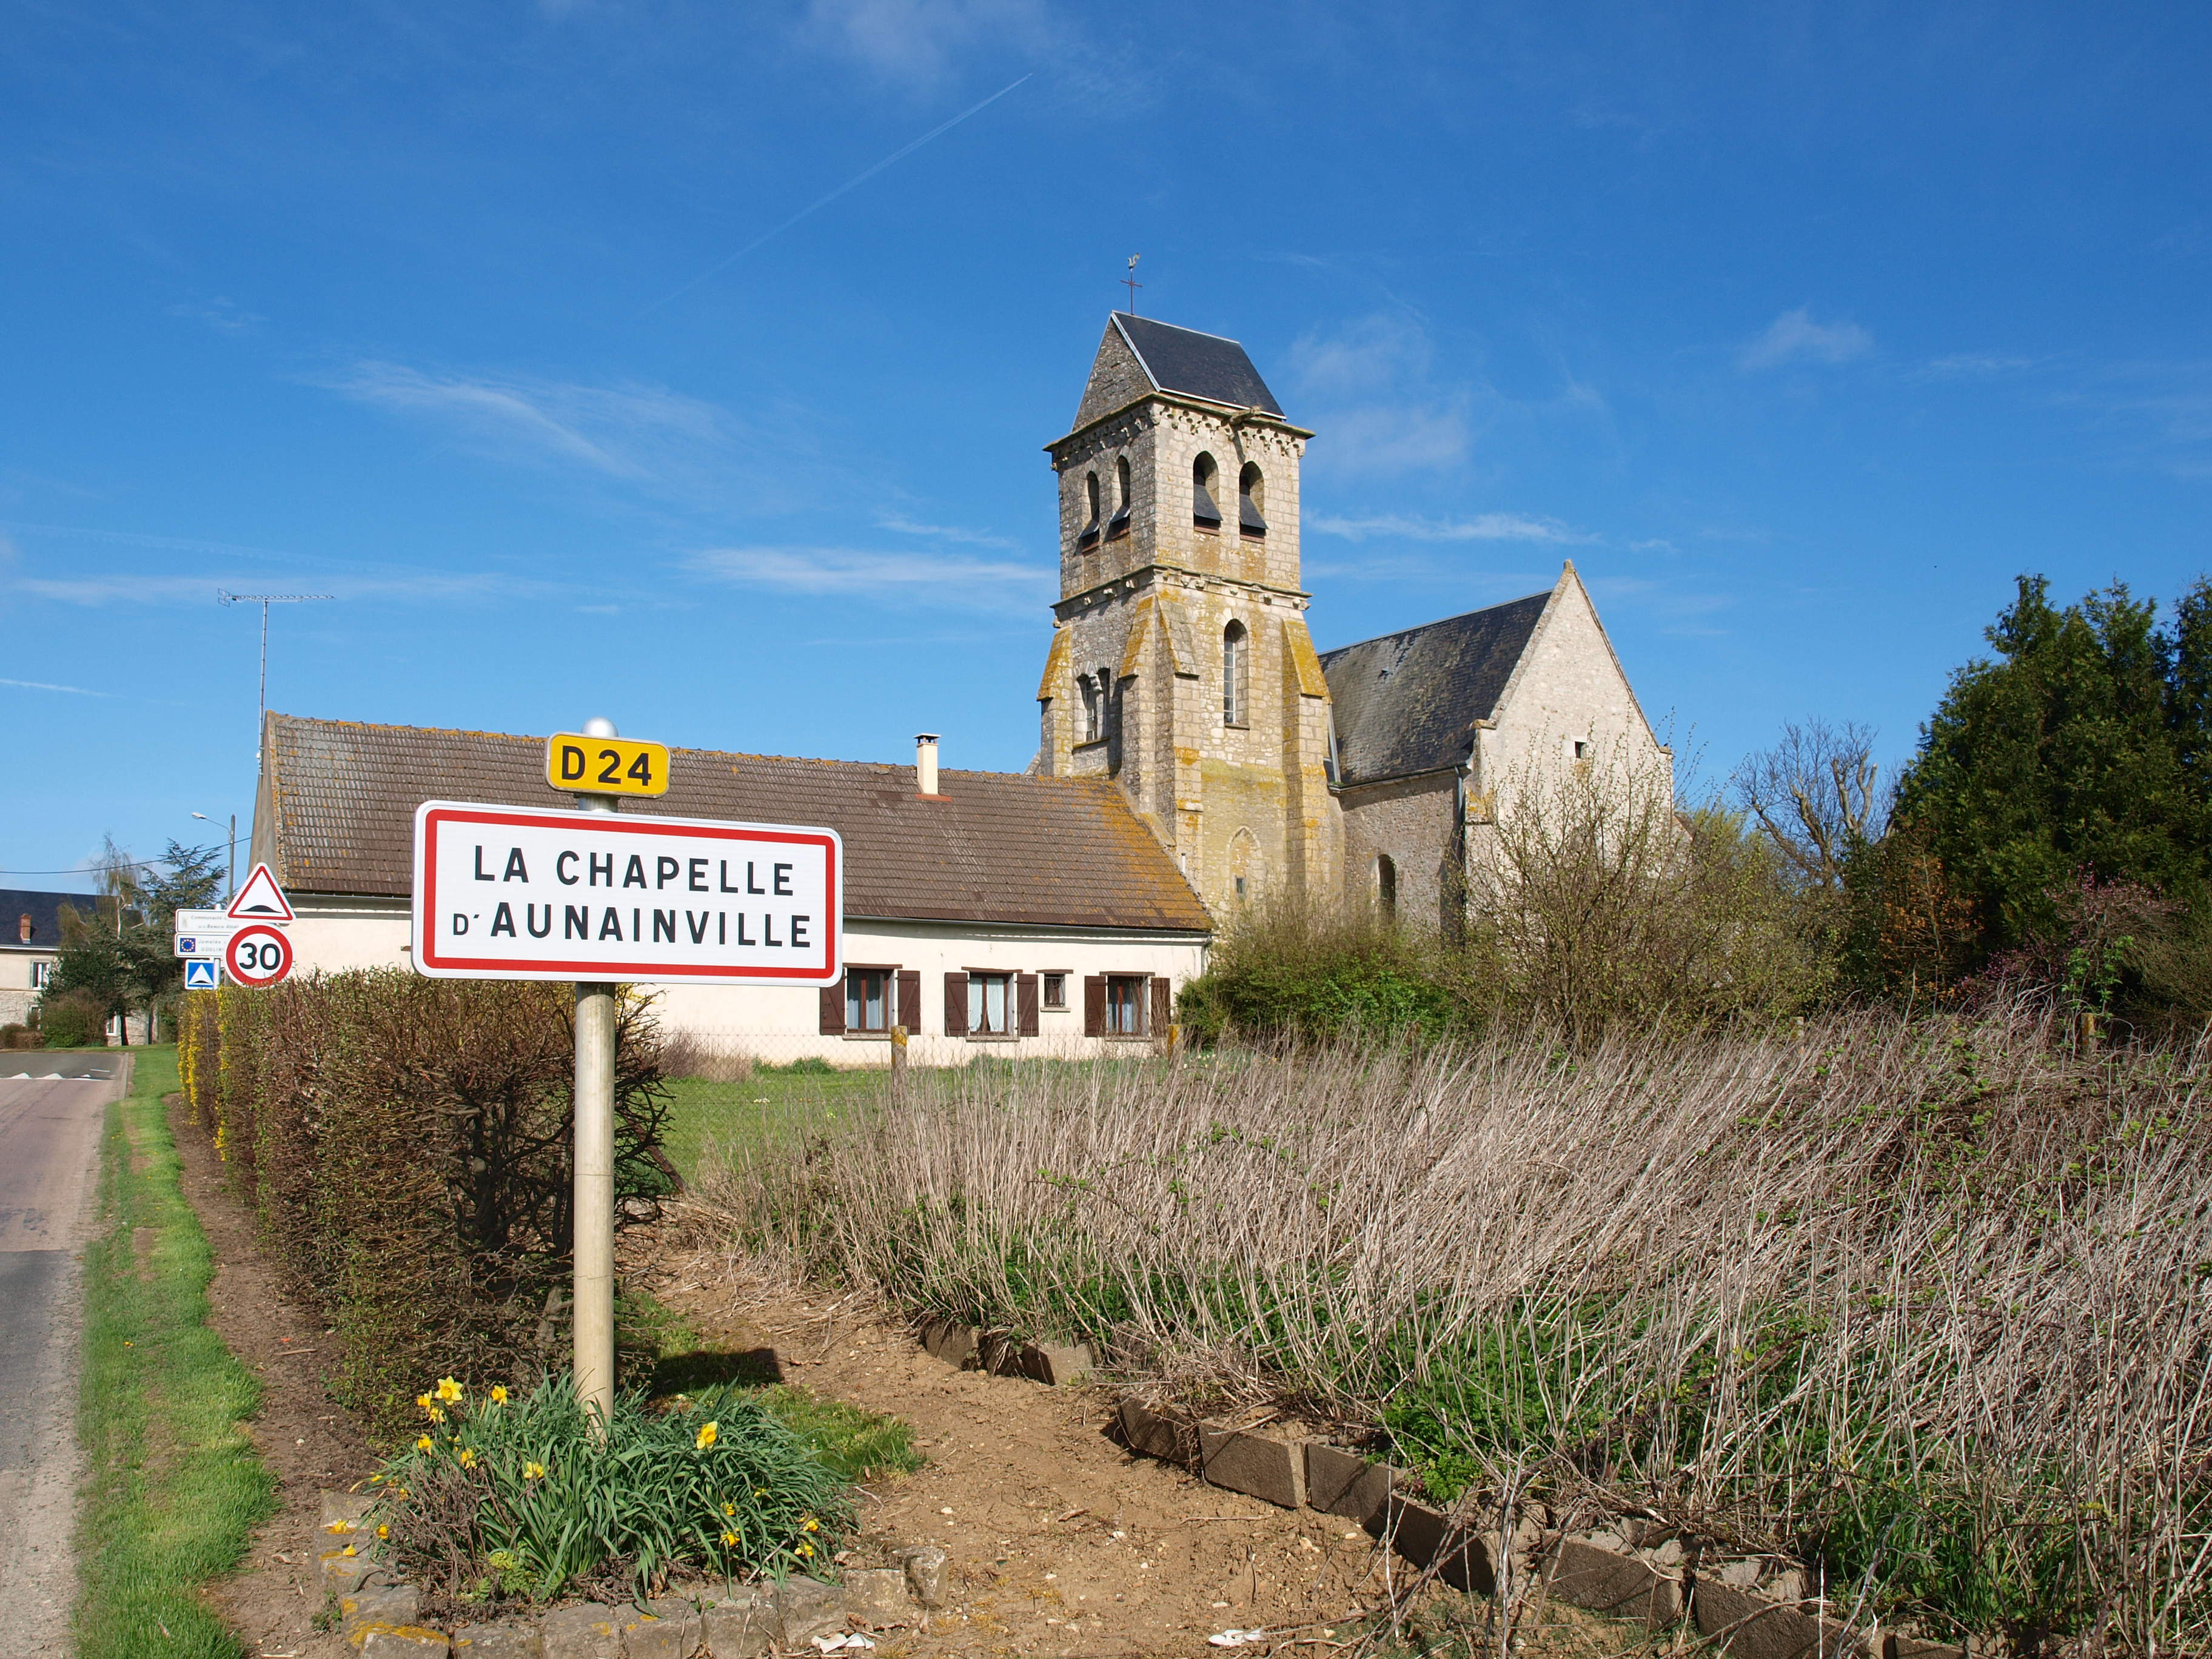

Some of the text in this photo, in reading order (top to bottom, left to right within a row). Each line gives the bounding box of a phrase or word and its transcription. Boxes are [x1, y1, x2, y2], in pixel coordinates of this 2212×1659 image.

[561, 745, 652, 787] D 24
[475, 845, 793, 896] LA CHAPELLE
[238, 942, 281, 970] 30
